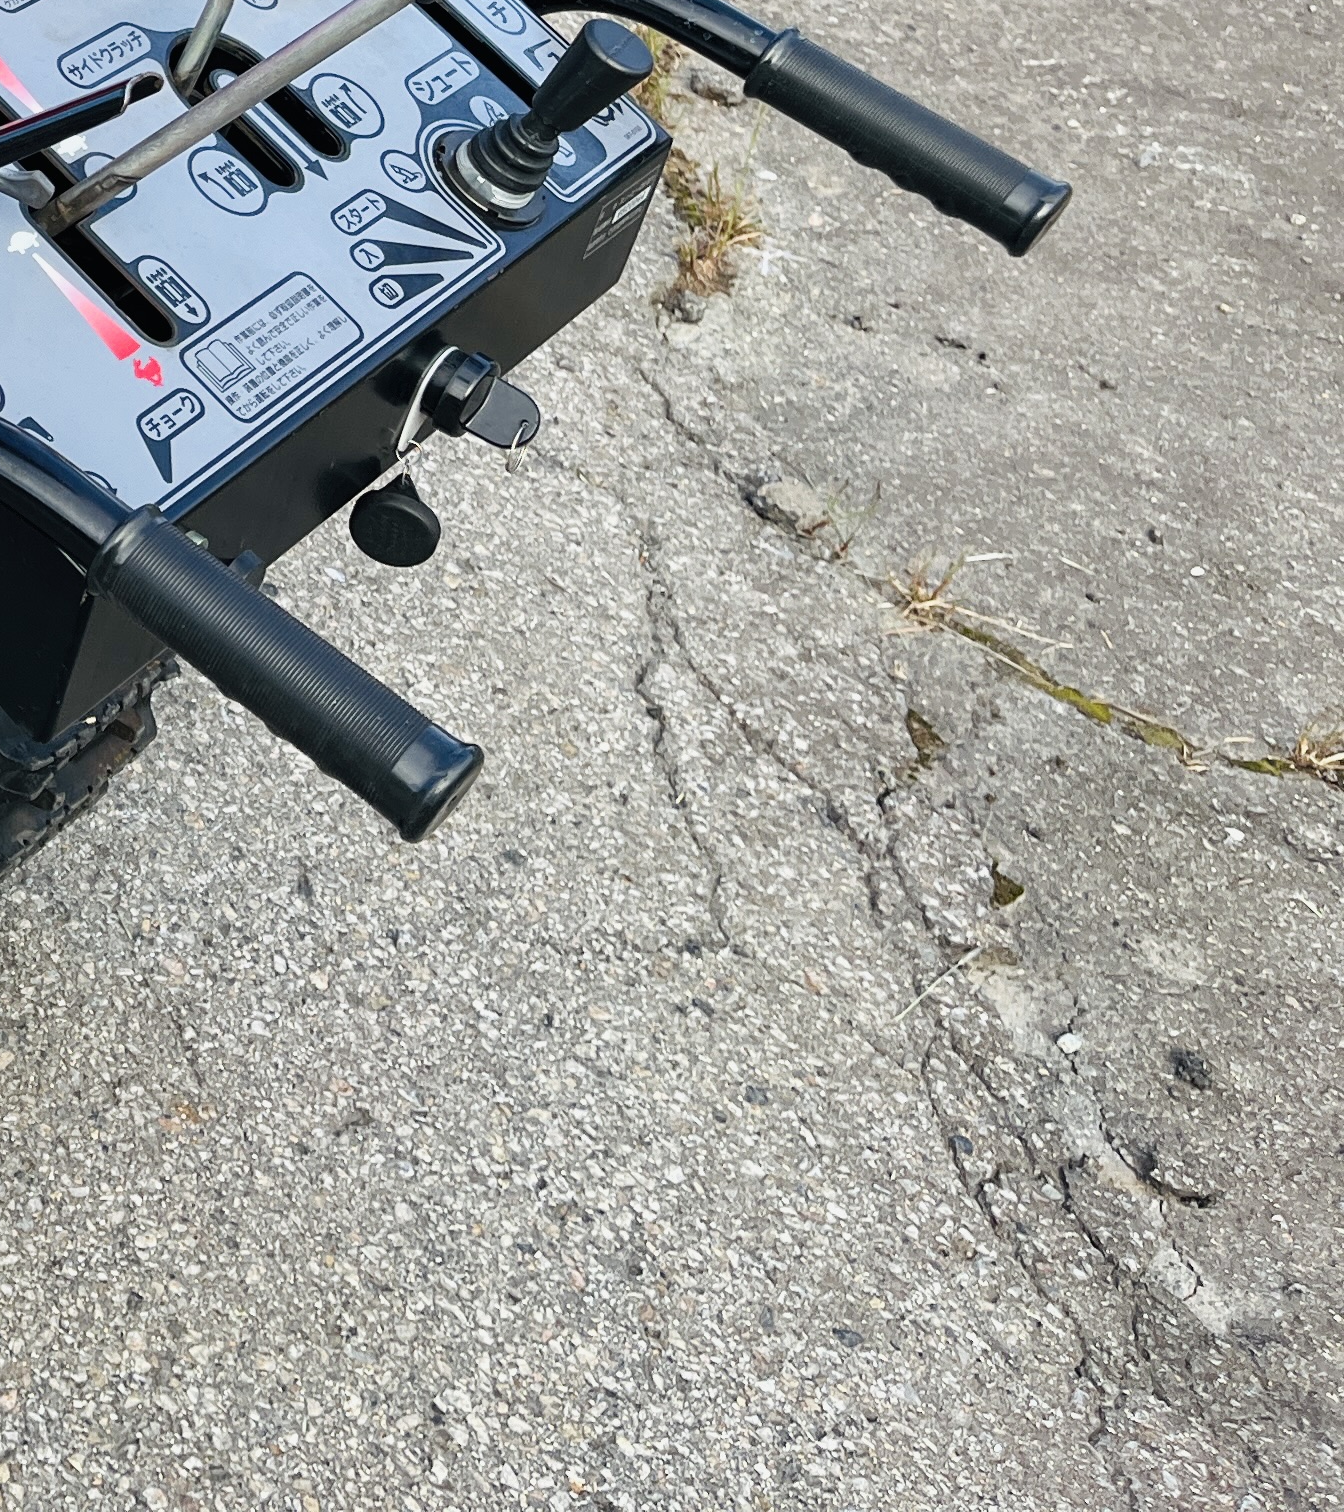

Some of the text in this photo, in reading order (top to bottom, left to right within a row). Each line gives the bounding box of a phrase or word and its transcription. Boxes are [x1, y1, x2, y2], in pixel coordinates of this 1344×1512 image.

[66, 30, 143, 81] サイドクラッチ
[412, 55, 472, 101] シュート
[338, 196, 380, 230] スタート
[358, 248, 380, 265] 入
[377, 282, 400, 301] 切
[145, 395, 196, 437] チョーク
